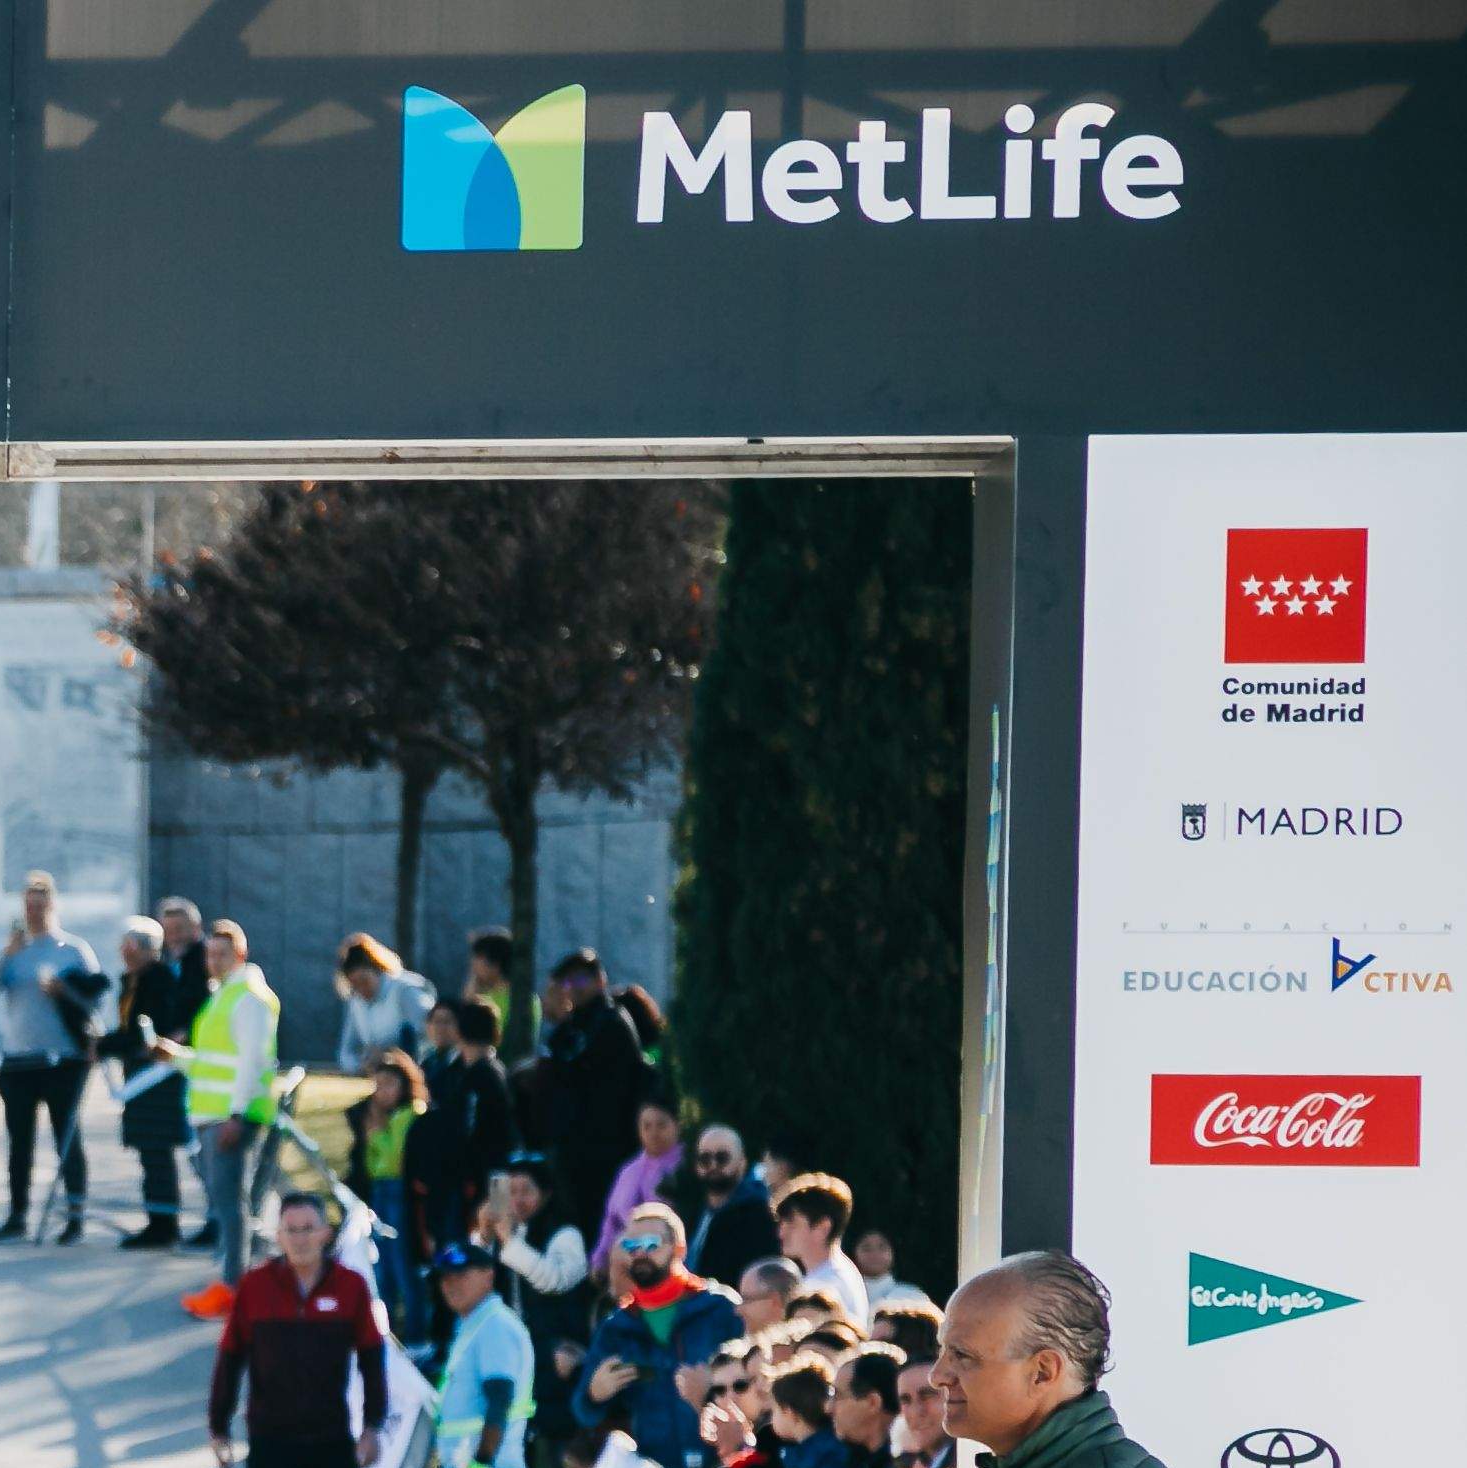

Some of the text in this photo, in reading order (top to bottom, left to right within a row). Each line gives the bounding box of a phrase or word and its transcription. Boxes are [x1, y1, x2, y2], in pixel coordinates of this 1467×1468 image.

[637, 102, 1185, 225] MetLife
[1222, 677, 1367, 696] Comunidad
[1222, 704, 1365, 724] de Madrid
[1237, 807, 1404, 837] MADRID
[1123, 964, 1309, 994] EDUCACIÓN
